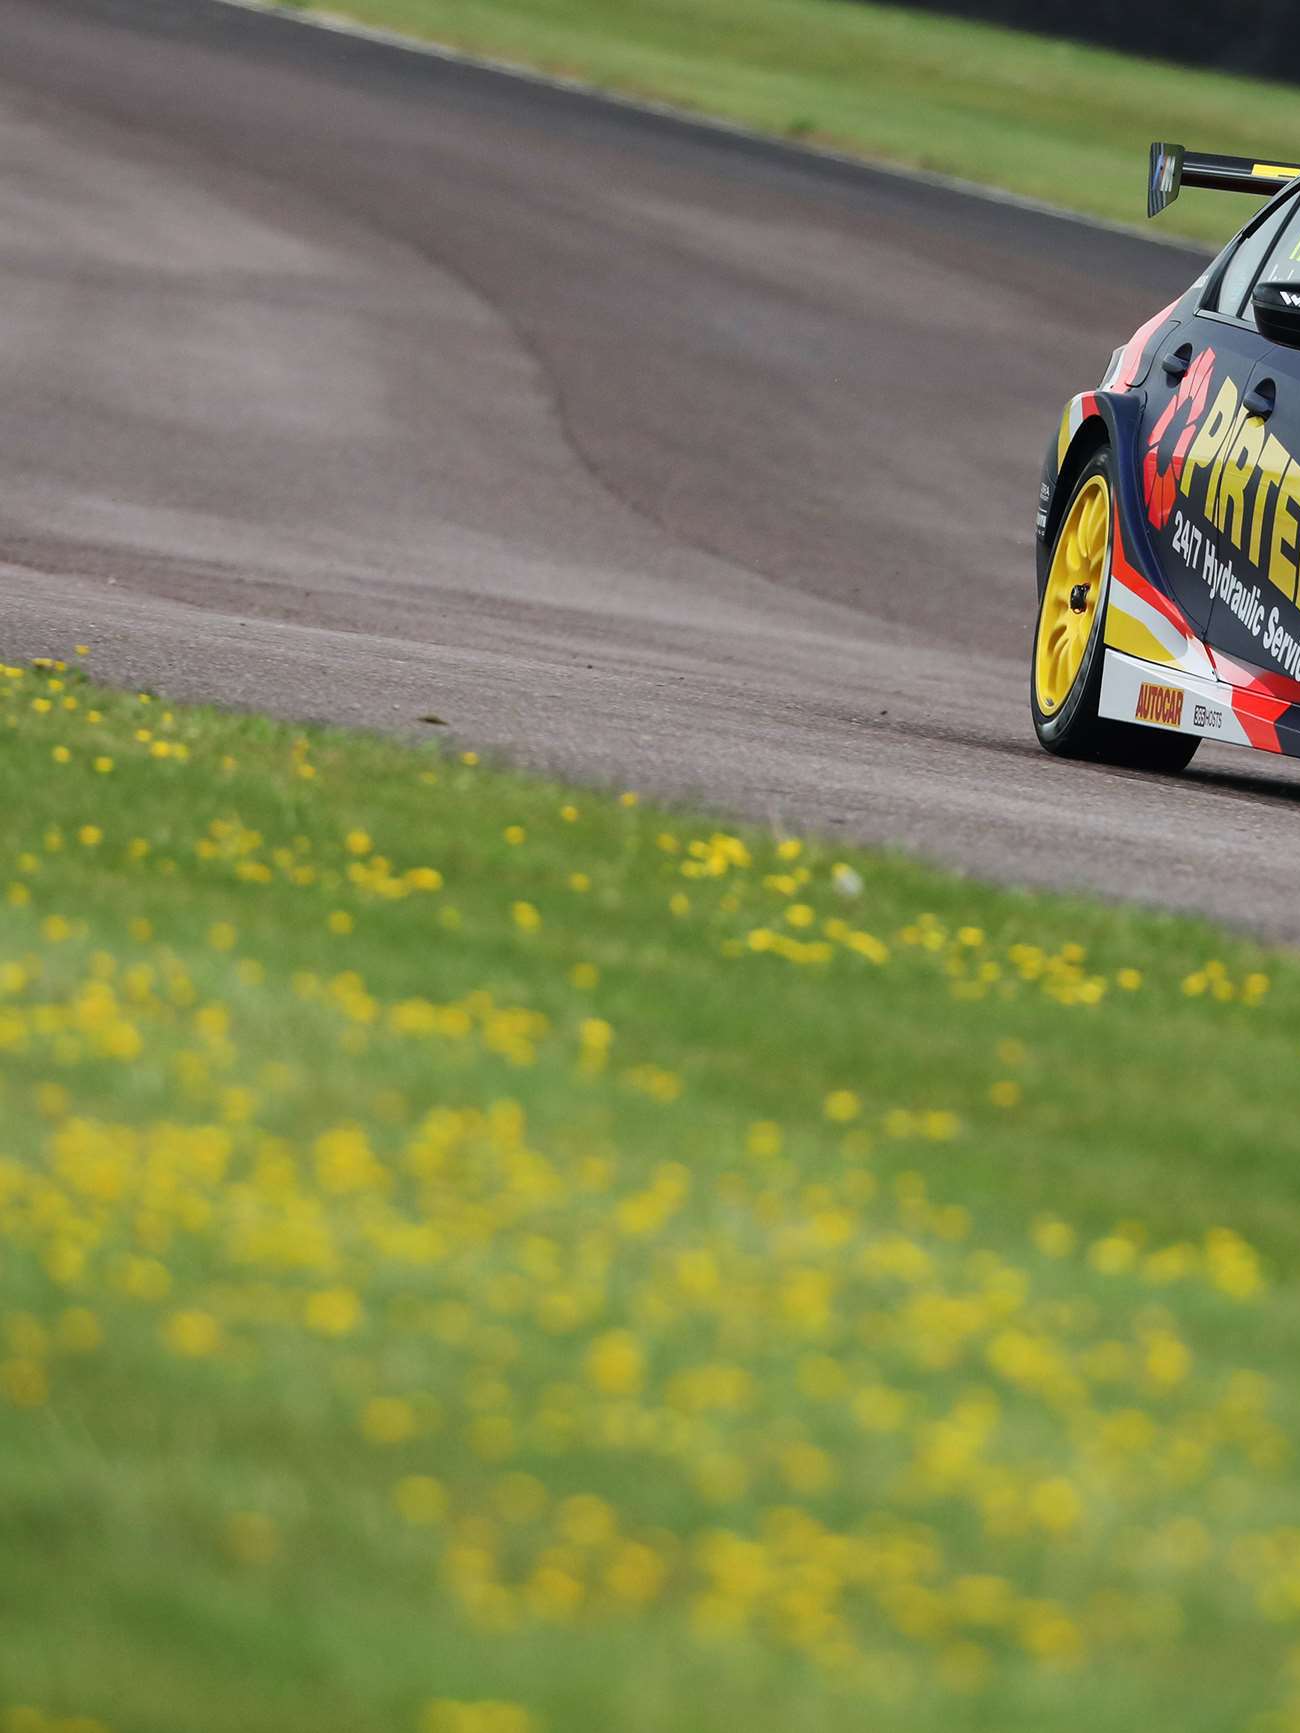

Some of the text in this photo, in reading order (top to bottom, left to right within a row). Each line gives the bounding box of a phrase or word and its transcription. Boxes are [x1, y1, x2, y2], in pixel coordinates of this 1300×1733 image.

[1172, 510, 1203, 569] 24/7
[1202, 538, 1265, 637] Hydraulic
[1135, 684, 1184, 726] AUTOCAR
